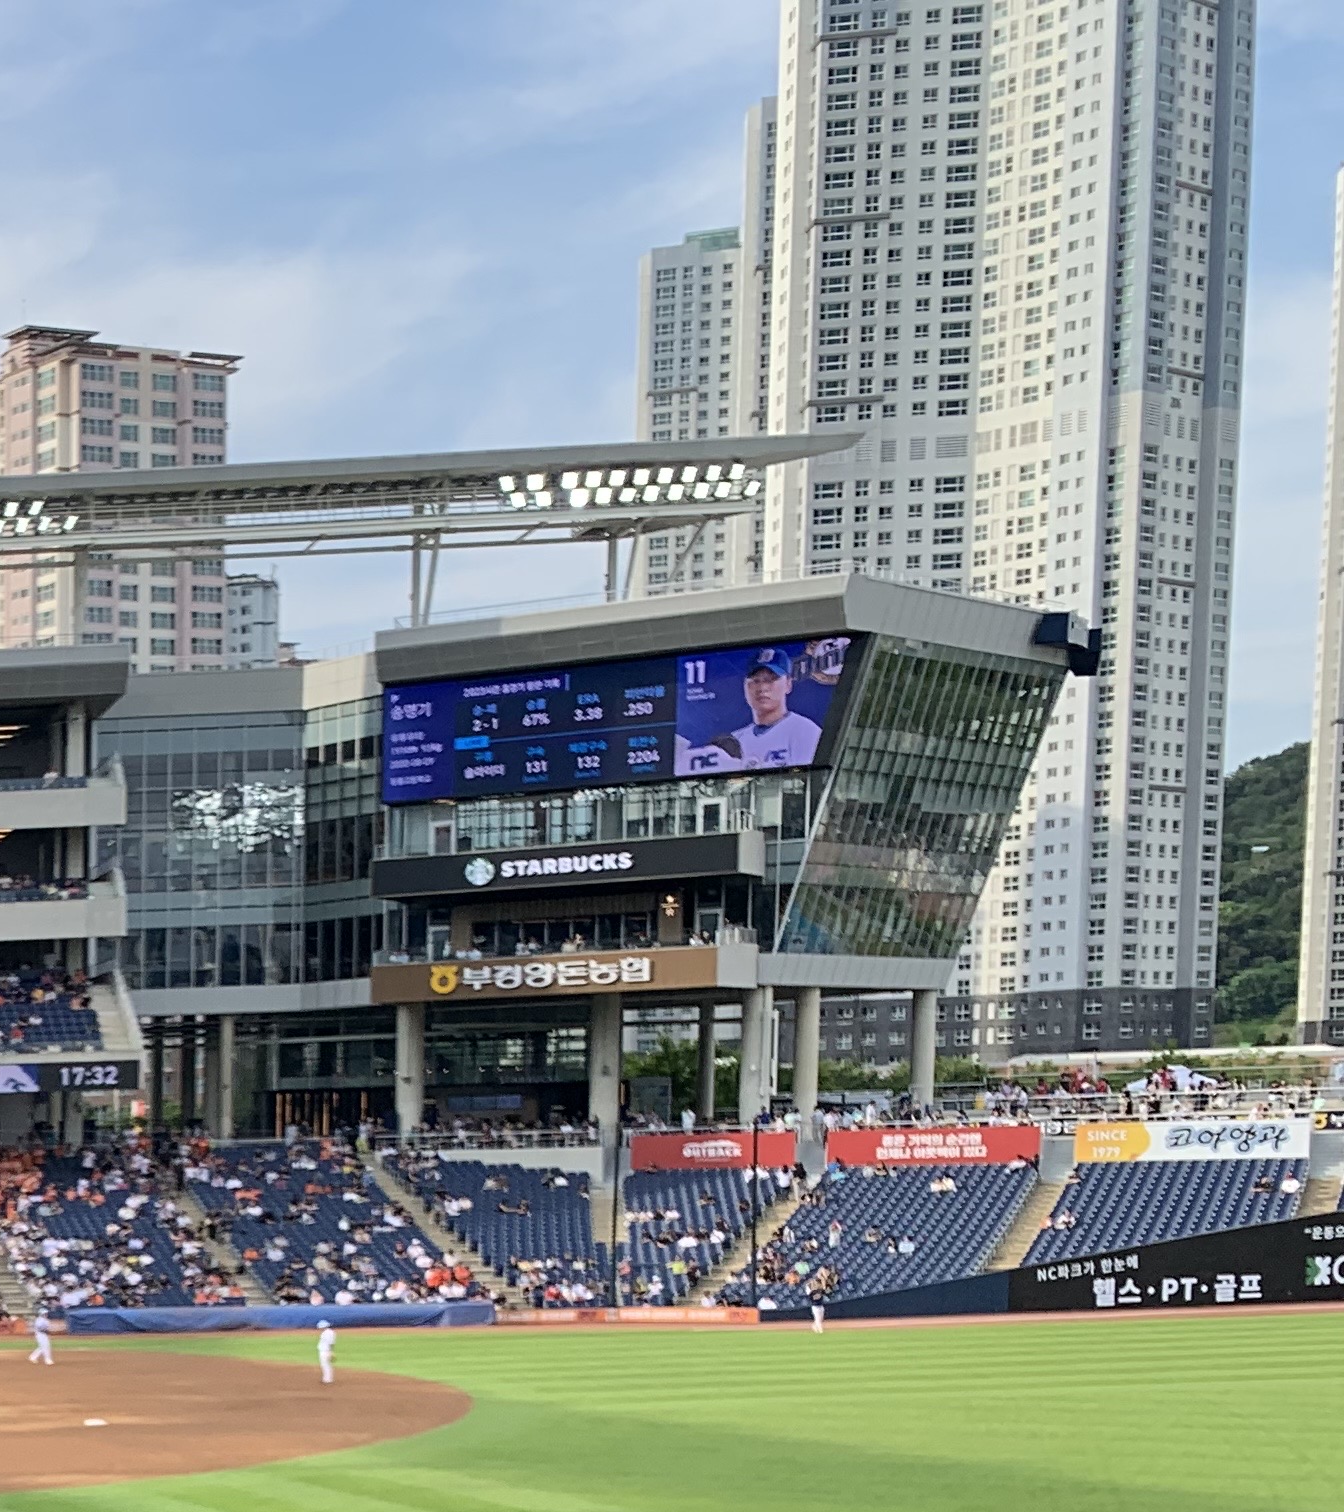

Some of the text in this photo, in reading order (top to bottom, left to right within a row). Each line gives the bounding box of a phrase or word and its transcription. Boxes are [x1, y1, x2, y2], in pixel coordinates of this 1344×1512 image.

[684, 660, 707, 685] 11
[522, 713, 550, 728] 67%
[576, 755, 601, 769] 132
[627, 750, 661, 766] 2204
[525, 759, 548, 774] 131
[500, 851, 635, 878] STARBUCKS
[463, 956, 653, 991] 부경양돈농협
[58, 1064, 120, 1088] 17:32
[1087, 1129, 1128, 1142] SINCE
[682, 1146, 742, 1159] OUTBACK
[1092, 1146, 1121, 1158] 1979
[1037, 1255, 1139, 1283] NC파크가 한눈에
